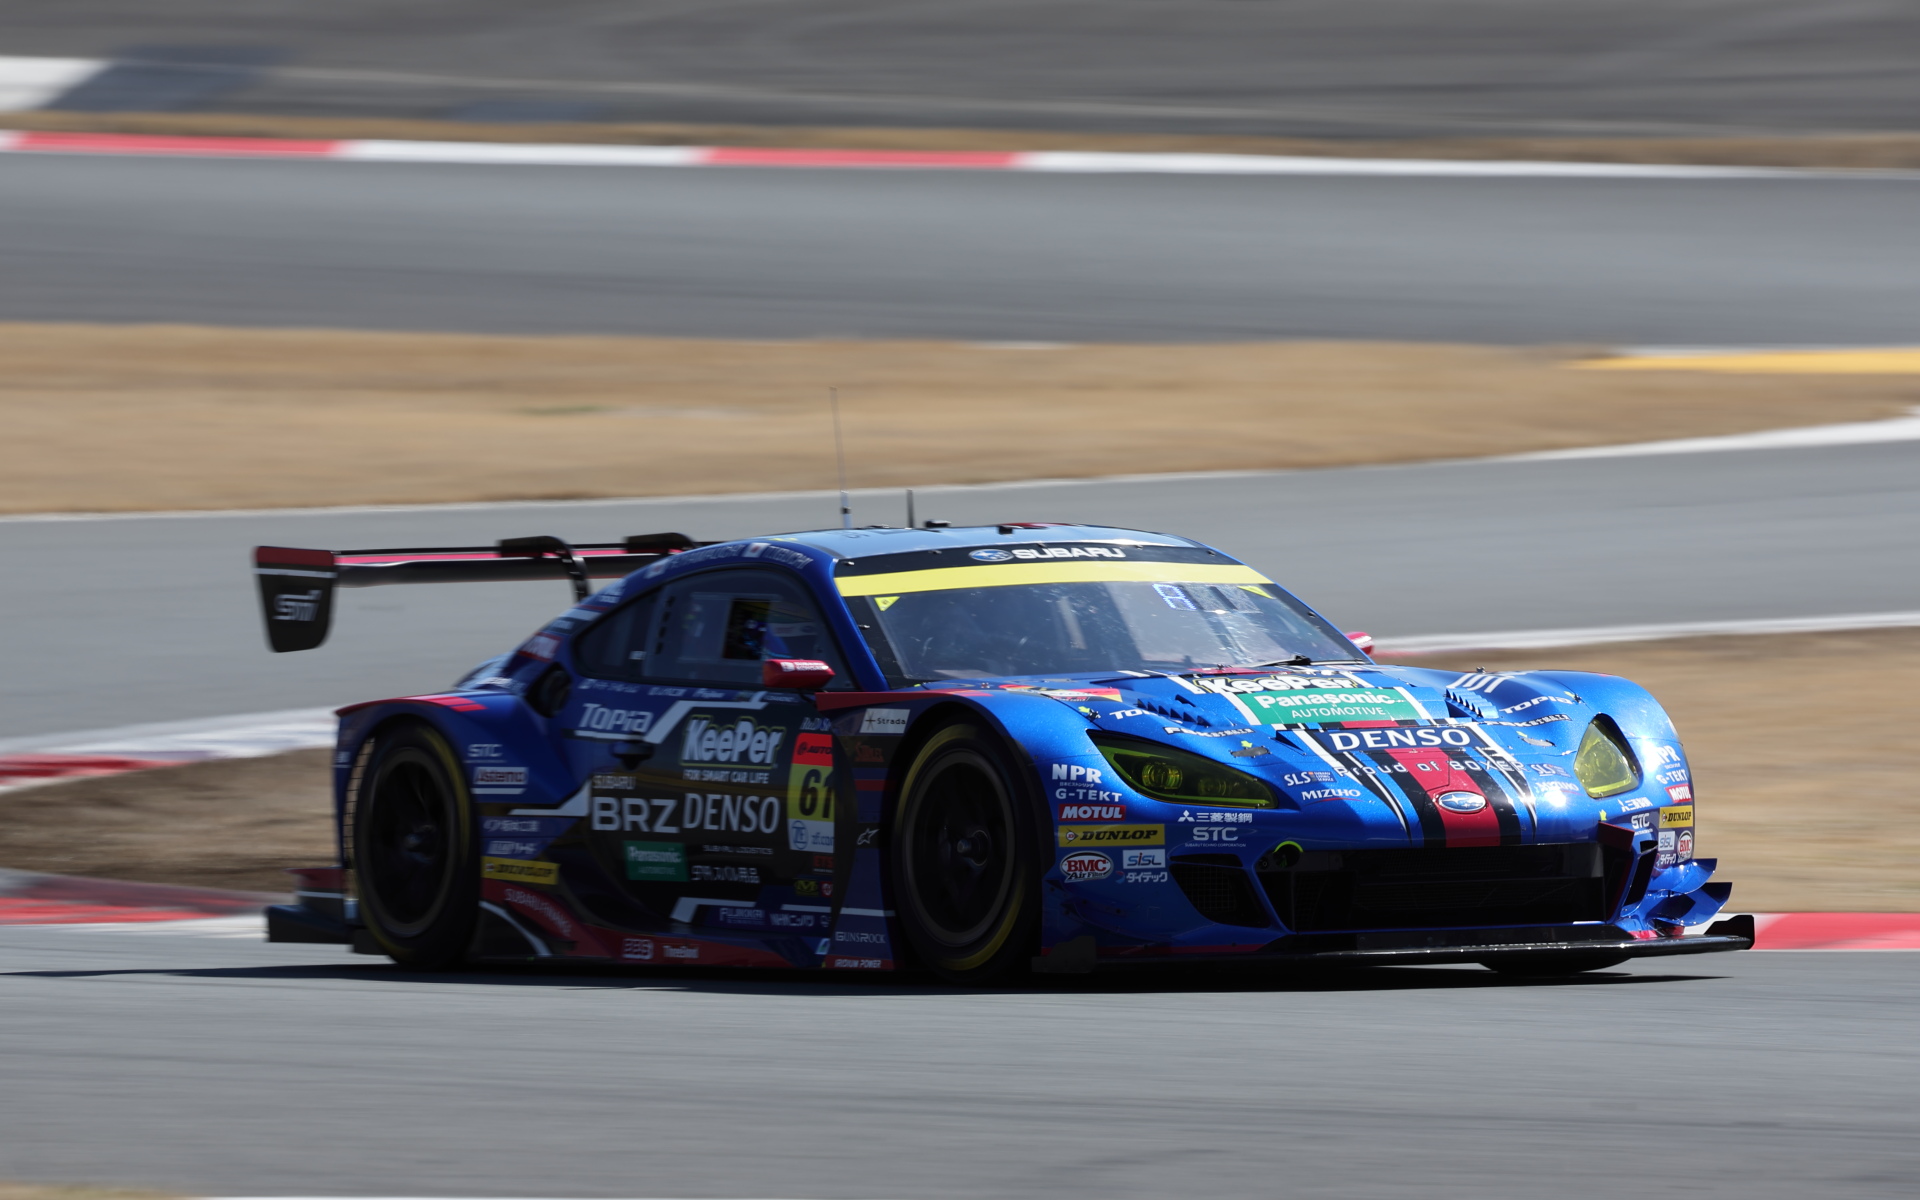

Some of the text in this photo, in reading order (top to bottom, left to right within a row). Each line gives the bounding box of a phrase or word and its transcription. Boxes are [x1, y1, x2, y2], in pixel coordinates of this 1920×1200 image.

[1012, 546, 1125, 559] SUBARU
[1200, 675, 1355, 694] KeePer
[1254, 692, 1395, 709] Panasonic
[1291, 706, 1386, 719] AUTOMOTIVE
[877, 717, 906, 726] Strada
[682, 717, 786, 764] KeePer
[1329, 728, 1471, 750] DENSO
[1051, 763, 1102, 783] NPR
[1333, 759, 1530, 777] Proud of BOXER
[592, 775, 637, 790] SUBARU
[702, 770, 730, 782] SMART
[731, 771, 749, 783] CAR
[749, 772, 770, 784] LIFE
[1284, 771, 1311, 786] SLS
[1655, 769, 1688, 785] G-TEKT
[800, 769, 834, 819] 61
[1055, 788, 1122, 802] G-TEKT
[1301, 788, 1361, 800] MIZUHO
[1669, 786, 1692, 800] MOTUL
[591, 796, 680, 834] BRZ
[681, 792, 781, 834] DENSO
[1061, 806, 1122, 819] MOTUL
[1196, 812, 1253, 823] 三菱製鋼
[1667, 811, 1692, 822] DUNLOP
[1631, 813, 1650, 829] STC
[1080, 830, 1158, 841] DUNLOP
[1192, 826, 1239, 841] STC
[626, 846, 682, 863] Panasonic
[1066, 859, 1107, 872] BMC
[1068, 872, 1087, 880] Air
[1126, 872, 1168, 883] ダイテック
[859, 959, 882, 968] POWER
